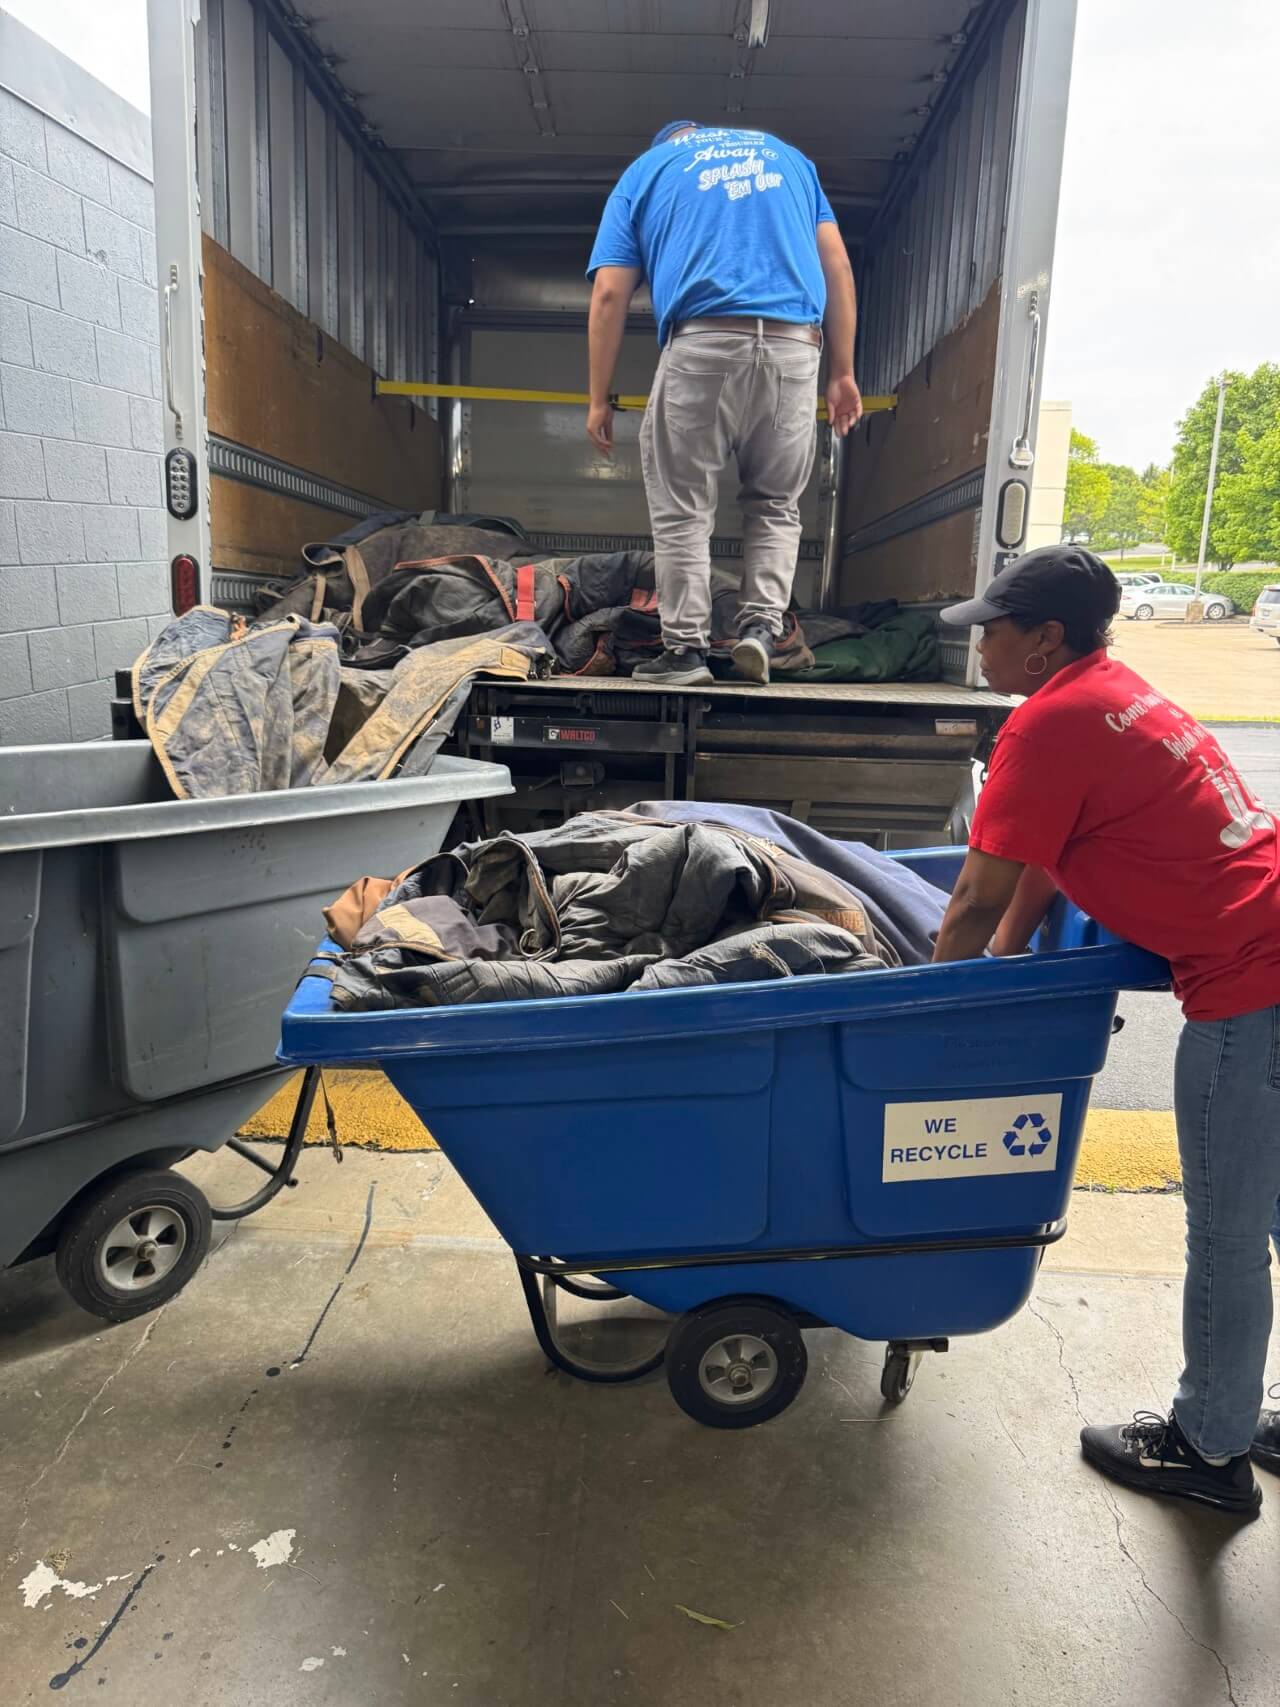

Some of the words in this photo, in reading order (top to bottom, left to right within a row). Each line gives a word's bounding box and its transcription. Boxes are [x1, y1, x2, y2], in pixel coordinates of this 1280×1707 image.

[674, 131, 728, 146] Wash
[684, 145, 757, 171] Away
[698, 159, 764, 190] SPLASH
[755, 173, 782, 191] OUT
[560, 729, 595, 742] WALTCO
[924, 1118, 957, 1134] WE
[891, 1143, 987, 1163] RECYCLE
